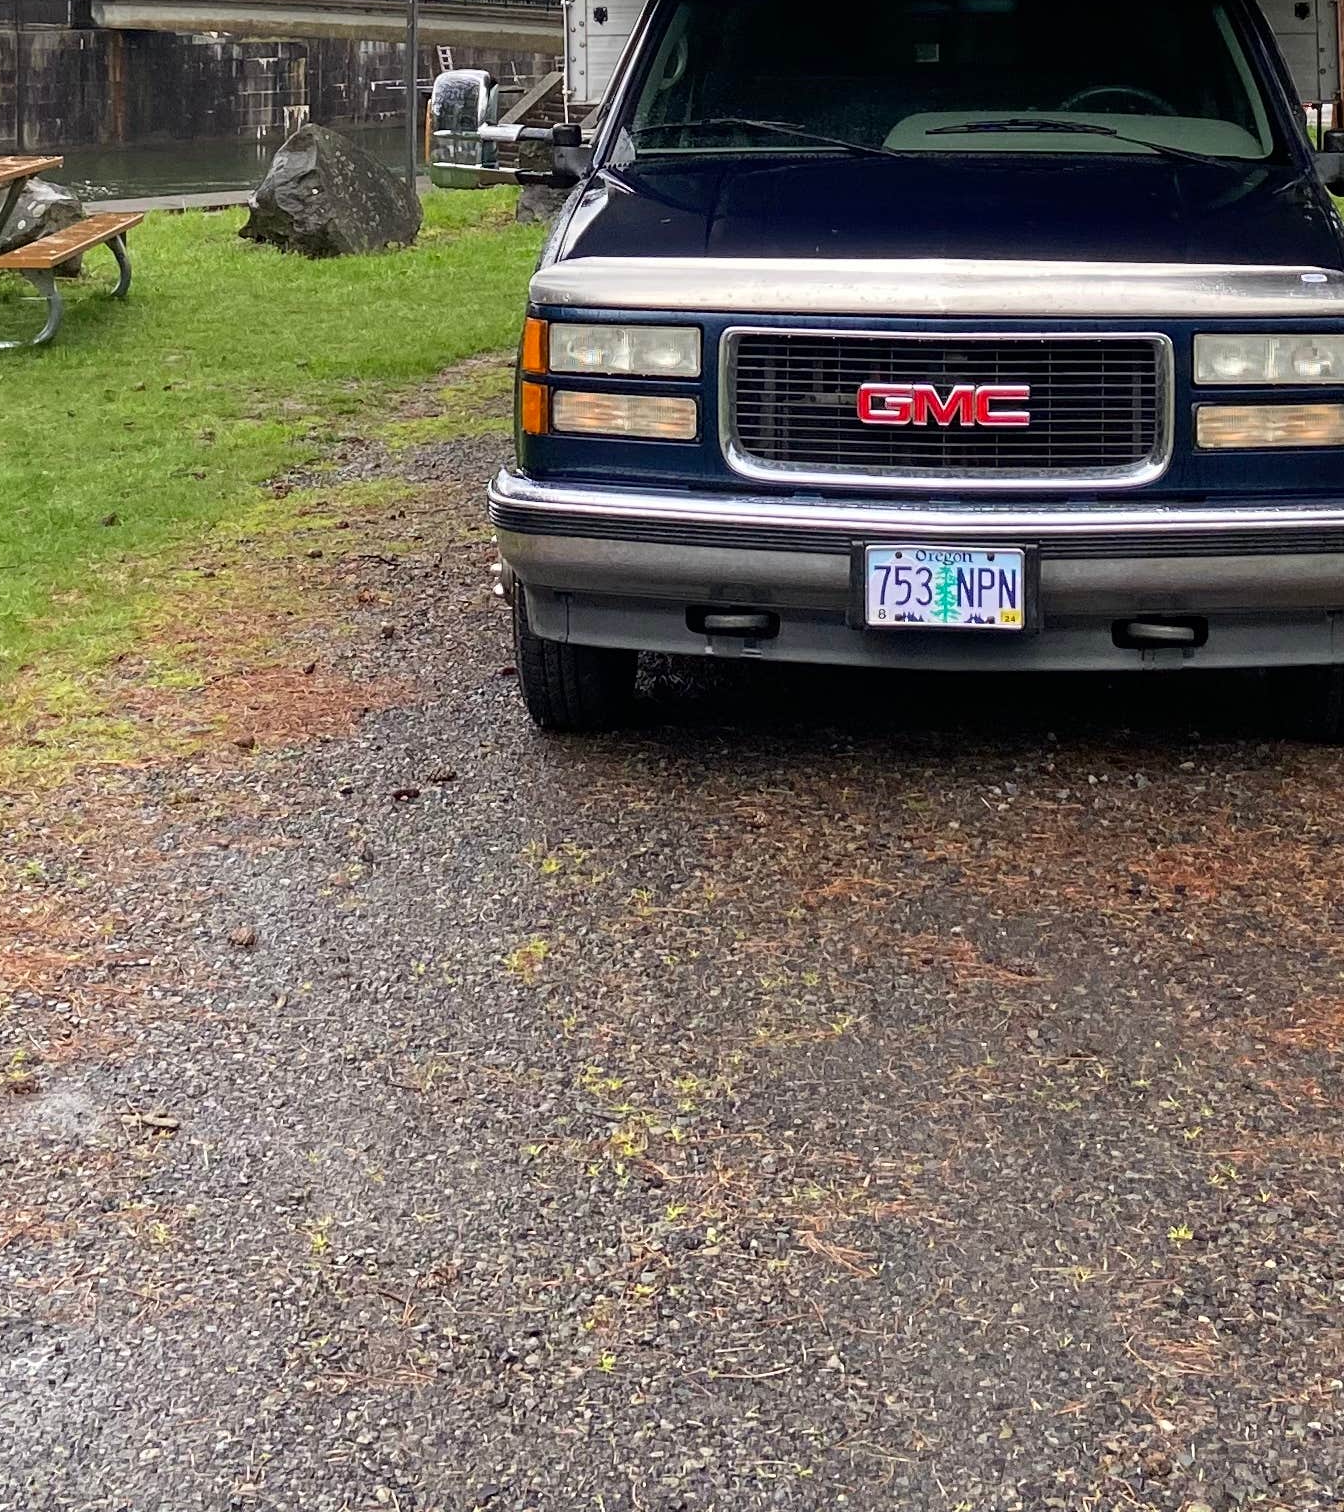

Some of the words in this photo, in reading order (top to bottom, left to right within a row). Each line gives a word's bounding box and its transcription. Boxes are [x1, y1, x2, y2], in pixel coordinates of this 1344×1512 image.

[857, 383, 1030, 426] GMC
[915, 549, 974, 565] Oregon
[873, 565, 933, 606] 753
[956, 567, 1017, 609] NPN
[878, 608, 887, 620] 8
[1004, 614, 1016, 623] 24
